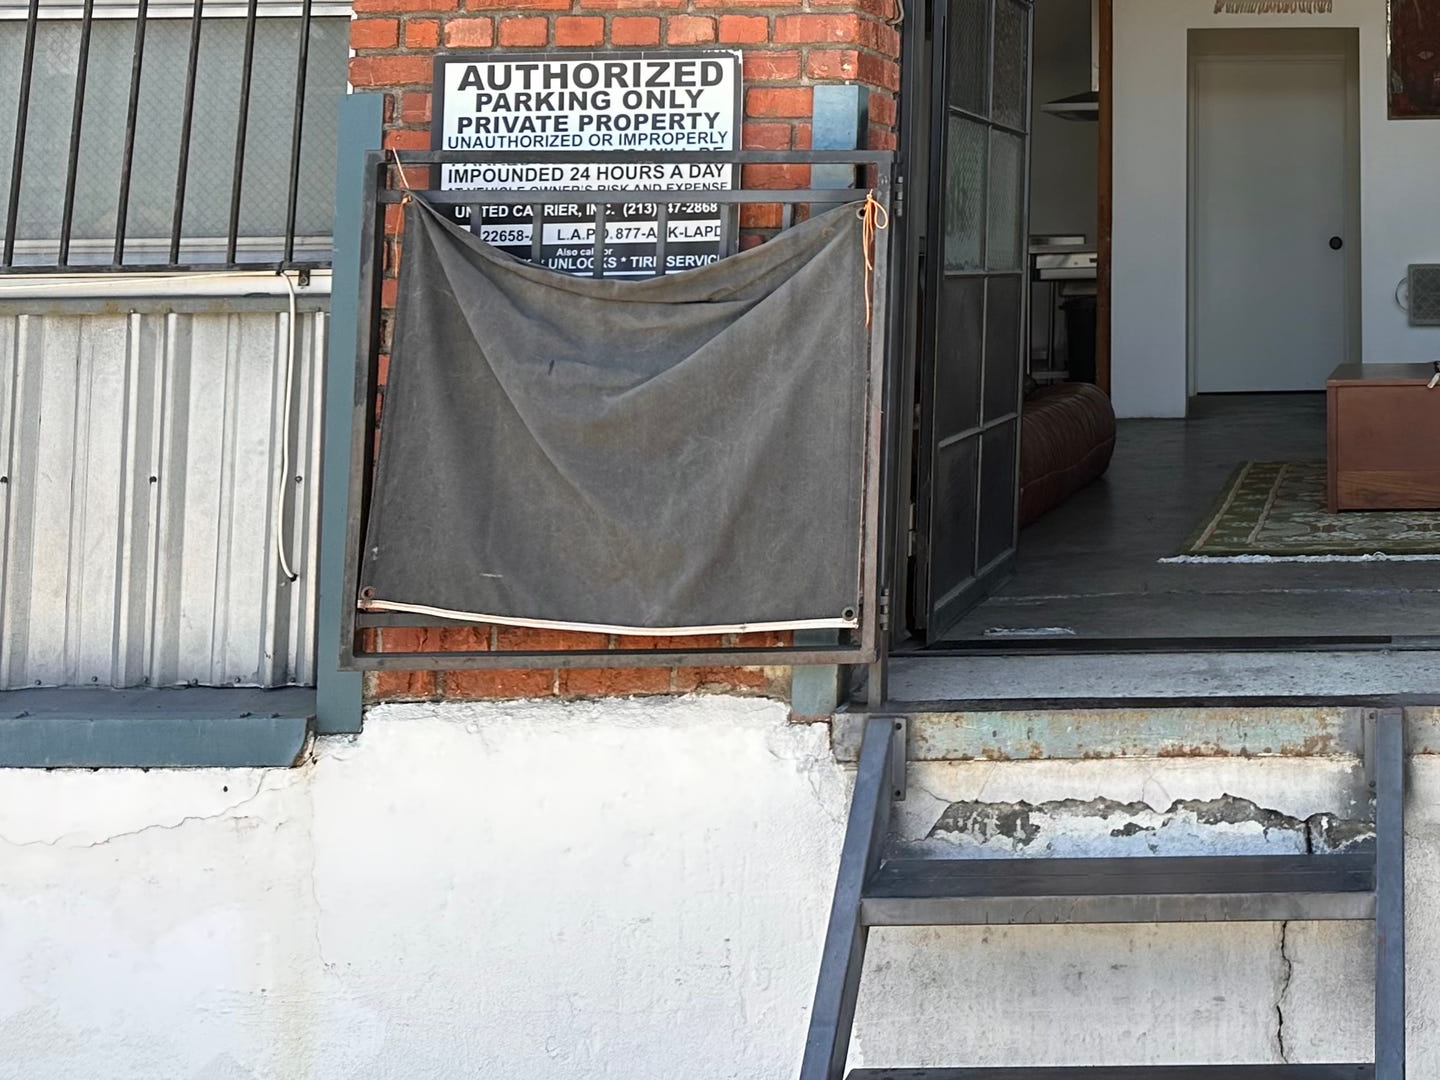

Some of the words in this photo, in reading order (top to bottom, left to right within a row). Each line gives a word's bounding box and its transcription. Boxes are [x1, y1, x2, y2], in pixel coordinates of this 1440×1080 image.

[457, 61, 723, 91] AUTHORIZED
[475, 90, 611, 112] PARKING
[622, 89, 704, 110] ONLY
[457, 114, 569, 134] PRIVATE
[578, 112, 720, 132] PROPERTY
[447, 135, 583, 149] UNAUTHORIZED
[588, 134, 613, 147] OR
[619, 131, 728, 146] IMPROPERLY
[448, 167, 564, 183] IMPOUNDED
[570, 167, 591, 181] 24
[597, 165, 665, 181] HOURS
[670, 165, 684, 179] A
[689, 164, 725, 179] DAY
[455, 205, 509, 218] UNTED
[512, 203, 582, 218] CARIER,
[623, 202, 657, 217] (213)
[482, 230, 532, 242] 22658-
[616, 226, 720, 239] 877-AK-LAP
[556, 248, 577, 257] Also
[580, 248, 594, 256] cal
[666, 255, 720, 267] SERVIC
